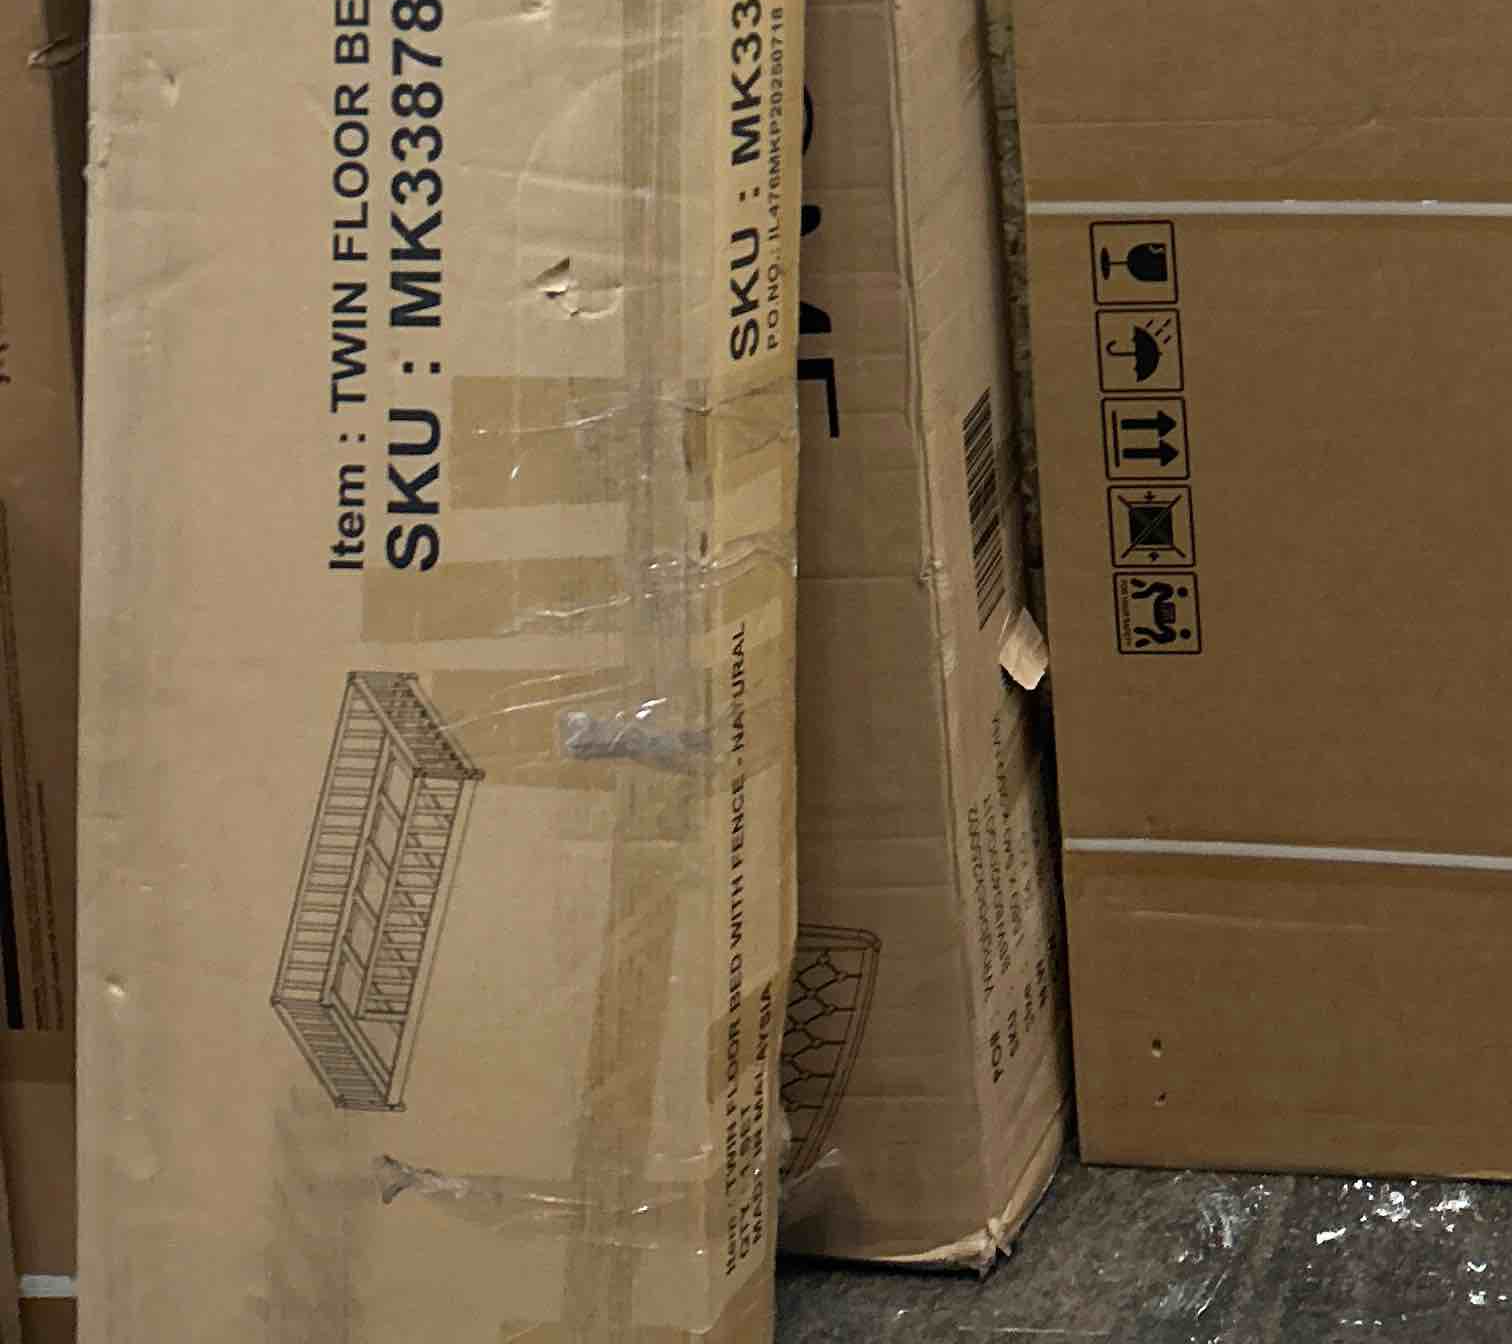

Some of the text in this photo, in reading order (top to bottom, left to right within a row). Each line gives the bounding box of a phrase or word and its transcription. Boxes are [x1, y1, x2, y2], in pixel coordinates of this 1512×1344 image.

[333, 83, 369, 262] FLOOR
[730, 228, 761, 359] SKU
[331, 281, 369, 412] TWIN
[330, 464, 366, 569] Item
[385, 409, 441, 571] SKU
[729, 775, 745, 868] FENCE
[729, 875, 744, 947] WITH
[728, 953, 742, 1012] BED
[726, 1017, 740, 1116] FLOOR
[752, 981, 771, 1245] MAD IN MALAYSIA
[725, 1121, 736, 1196] TWIN
[739, 1104, 750, 1157] SET
